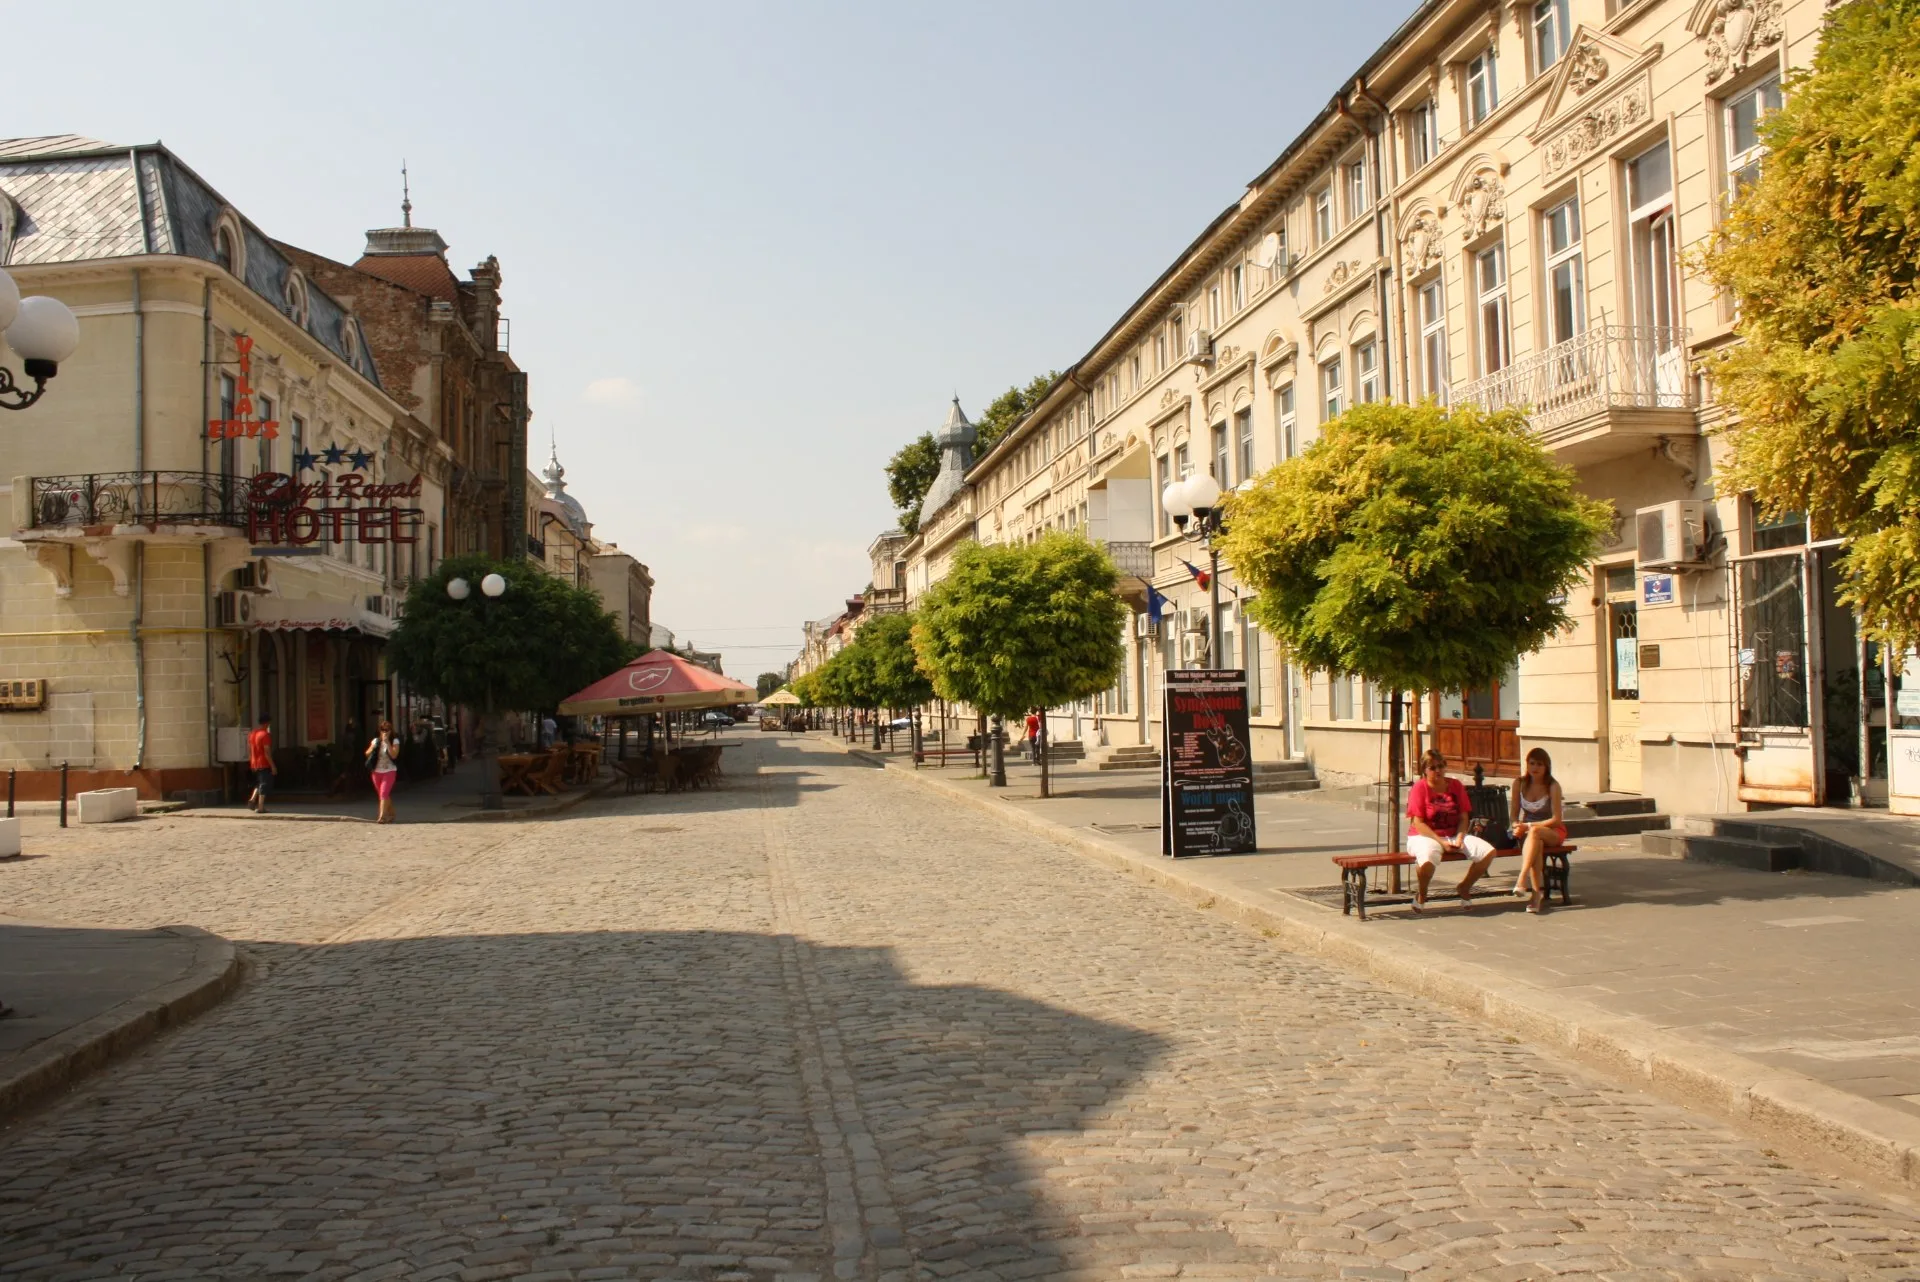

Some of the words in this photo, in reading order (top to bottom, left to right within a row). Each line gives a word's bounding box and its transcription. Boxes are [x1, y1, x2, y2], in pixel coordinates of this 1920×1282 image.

[235, 336, 253, 416] VILA
[208, 420, 280, 439] EDYS
[512, 379, 524, 468] HOTEL
[336, 473, 422, 506] Royal
[249, 506, 417, 544] HOTEL
[279, 619, 325, 628] Restaurant
[1182, 791, 1212, 805] World
